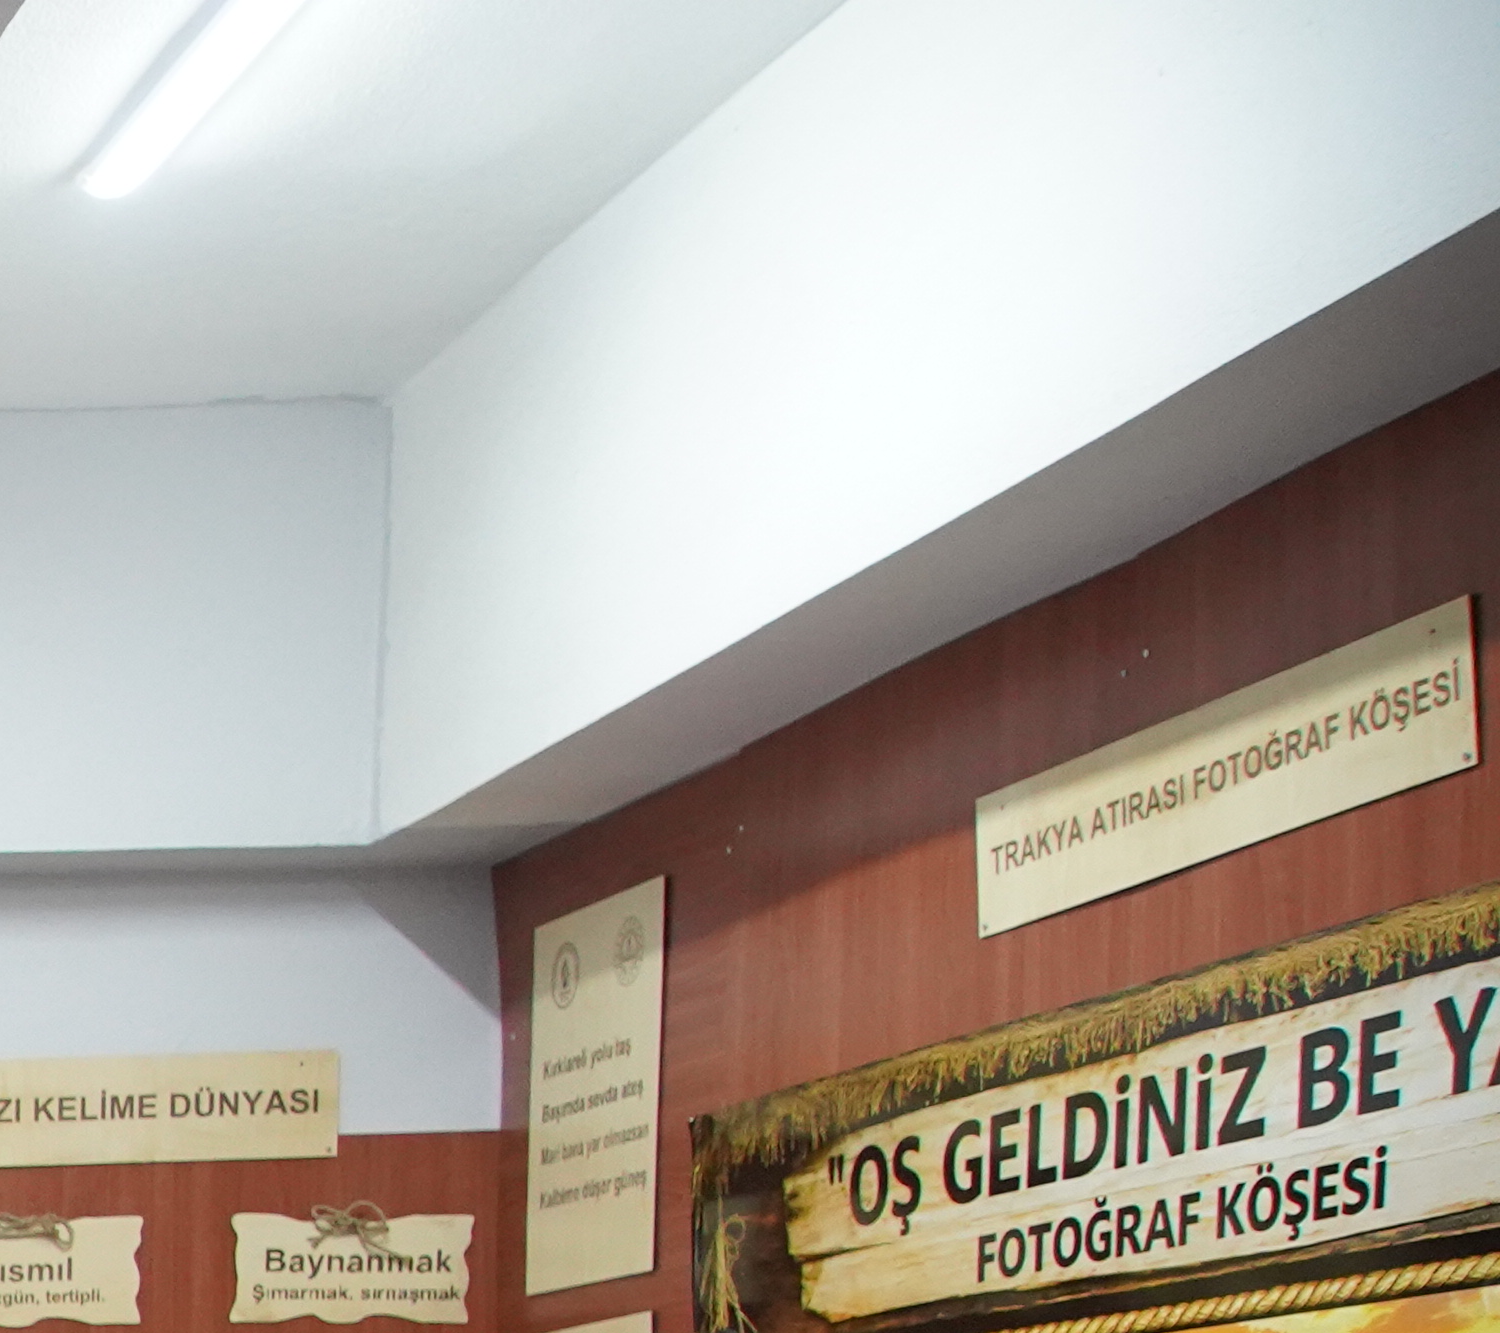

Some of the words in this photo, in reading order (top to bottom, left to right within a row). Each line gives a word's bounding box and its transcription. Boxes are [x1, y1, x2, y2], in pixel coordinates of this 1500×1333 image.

[991, 814, 1084, 876] TRAKYA
[1089, 774, 1186, 842] ATIRASI
[1192, 713, 1341, 803] FOTOĞRAF
[1348, 657, 1462, 742] KÖŞESİ
[1297, 1009, 1402, 1130] BE
[33, 1088, 158, 1123] KELİME
[169, 1086, 321, 1118] DÜNYASI
[264, 1247, 453, 1280] Baynanmak
[977, 1191, 1201, 1283] FOTOĞRAF
[45, 1287, 106, 1306] tertipli.
